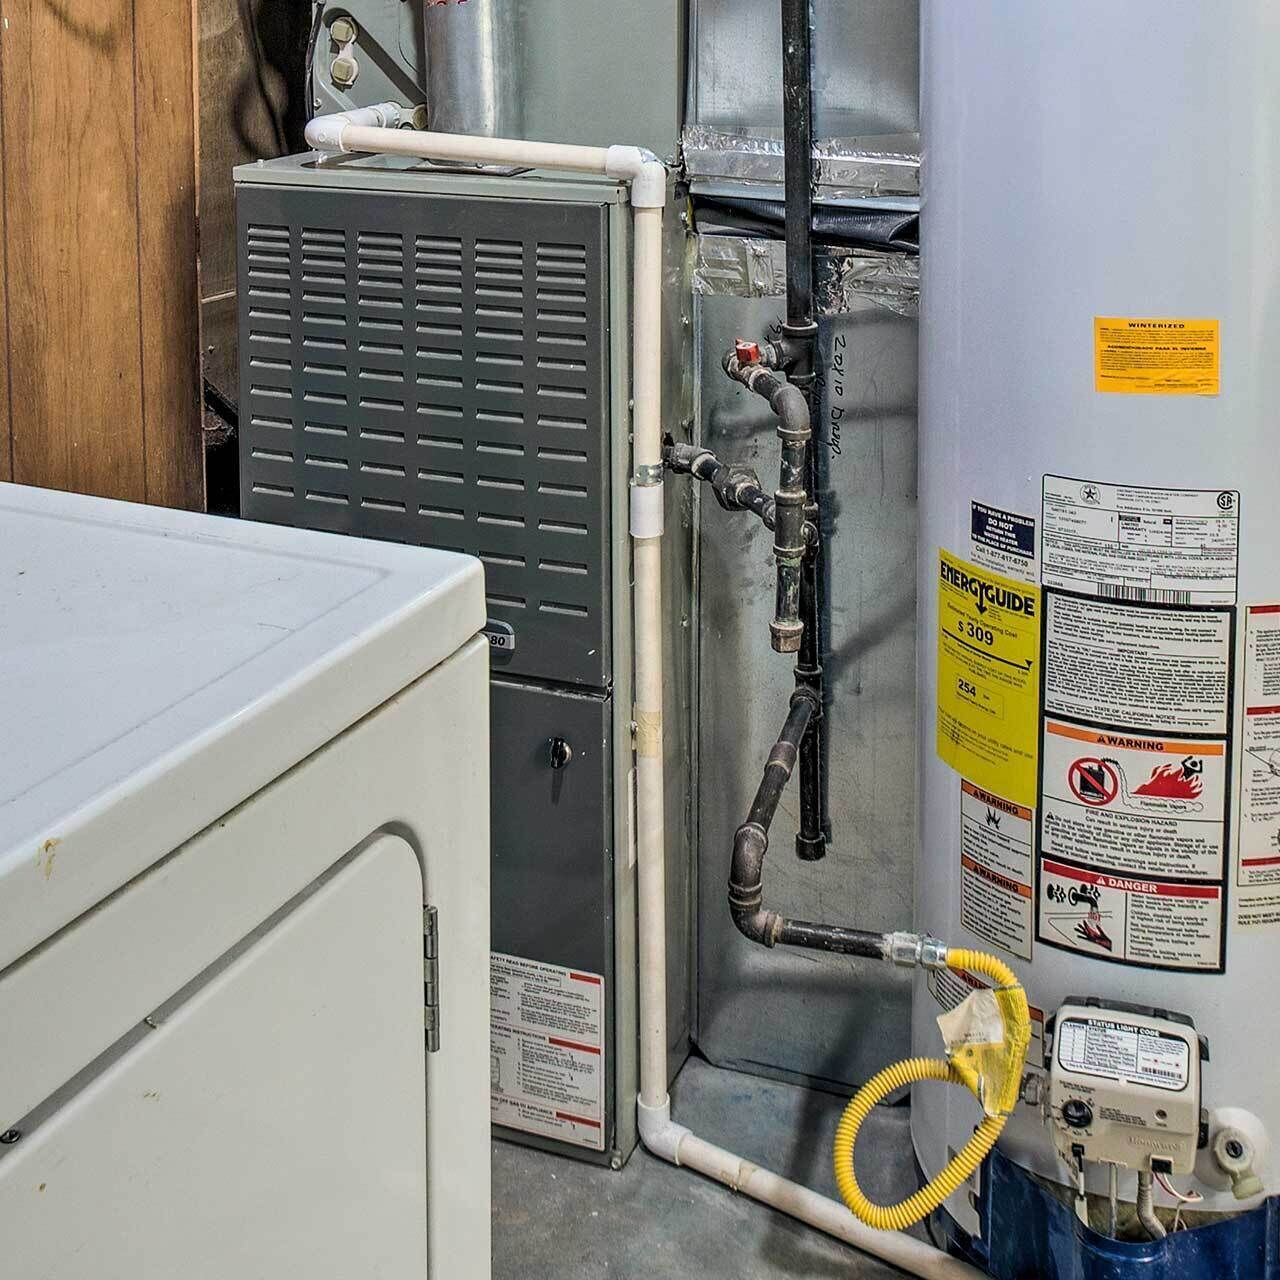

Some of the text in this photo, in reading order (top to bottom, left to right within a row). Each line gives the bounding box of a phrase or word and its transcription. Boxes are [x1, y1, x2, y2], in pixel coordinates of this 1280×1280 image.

[988, 517, 1014, 531] DO NOT
[940, 560, 1035, 617] ENERGYGUIDE
[490, 635, 506, 646] 80
[958, 620, 994, 646] $ 309
[1117, 648, 1148, 656] IMPORTANT
[958, 678, 976, 697] 254
[1106, 737, 1164, 752] WARNING
[979, 790, 1019, 815] WARNING
[1140, 800, 1167, 809] Flammable
[1108, 879, 1158, 894] DANGER
[1088, 1019, 1160, 1037] STATUS LIGHT CODE
